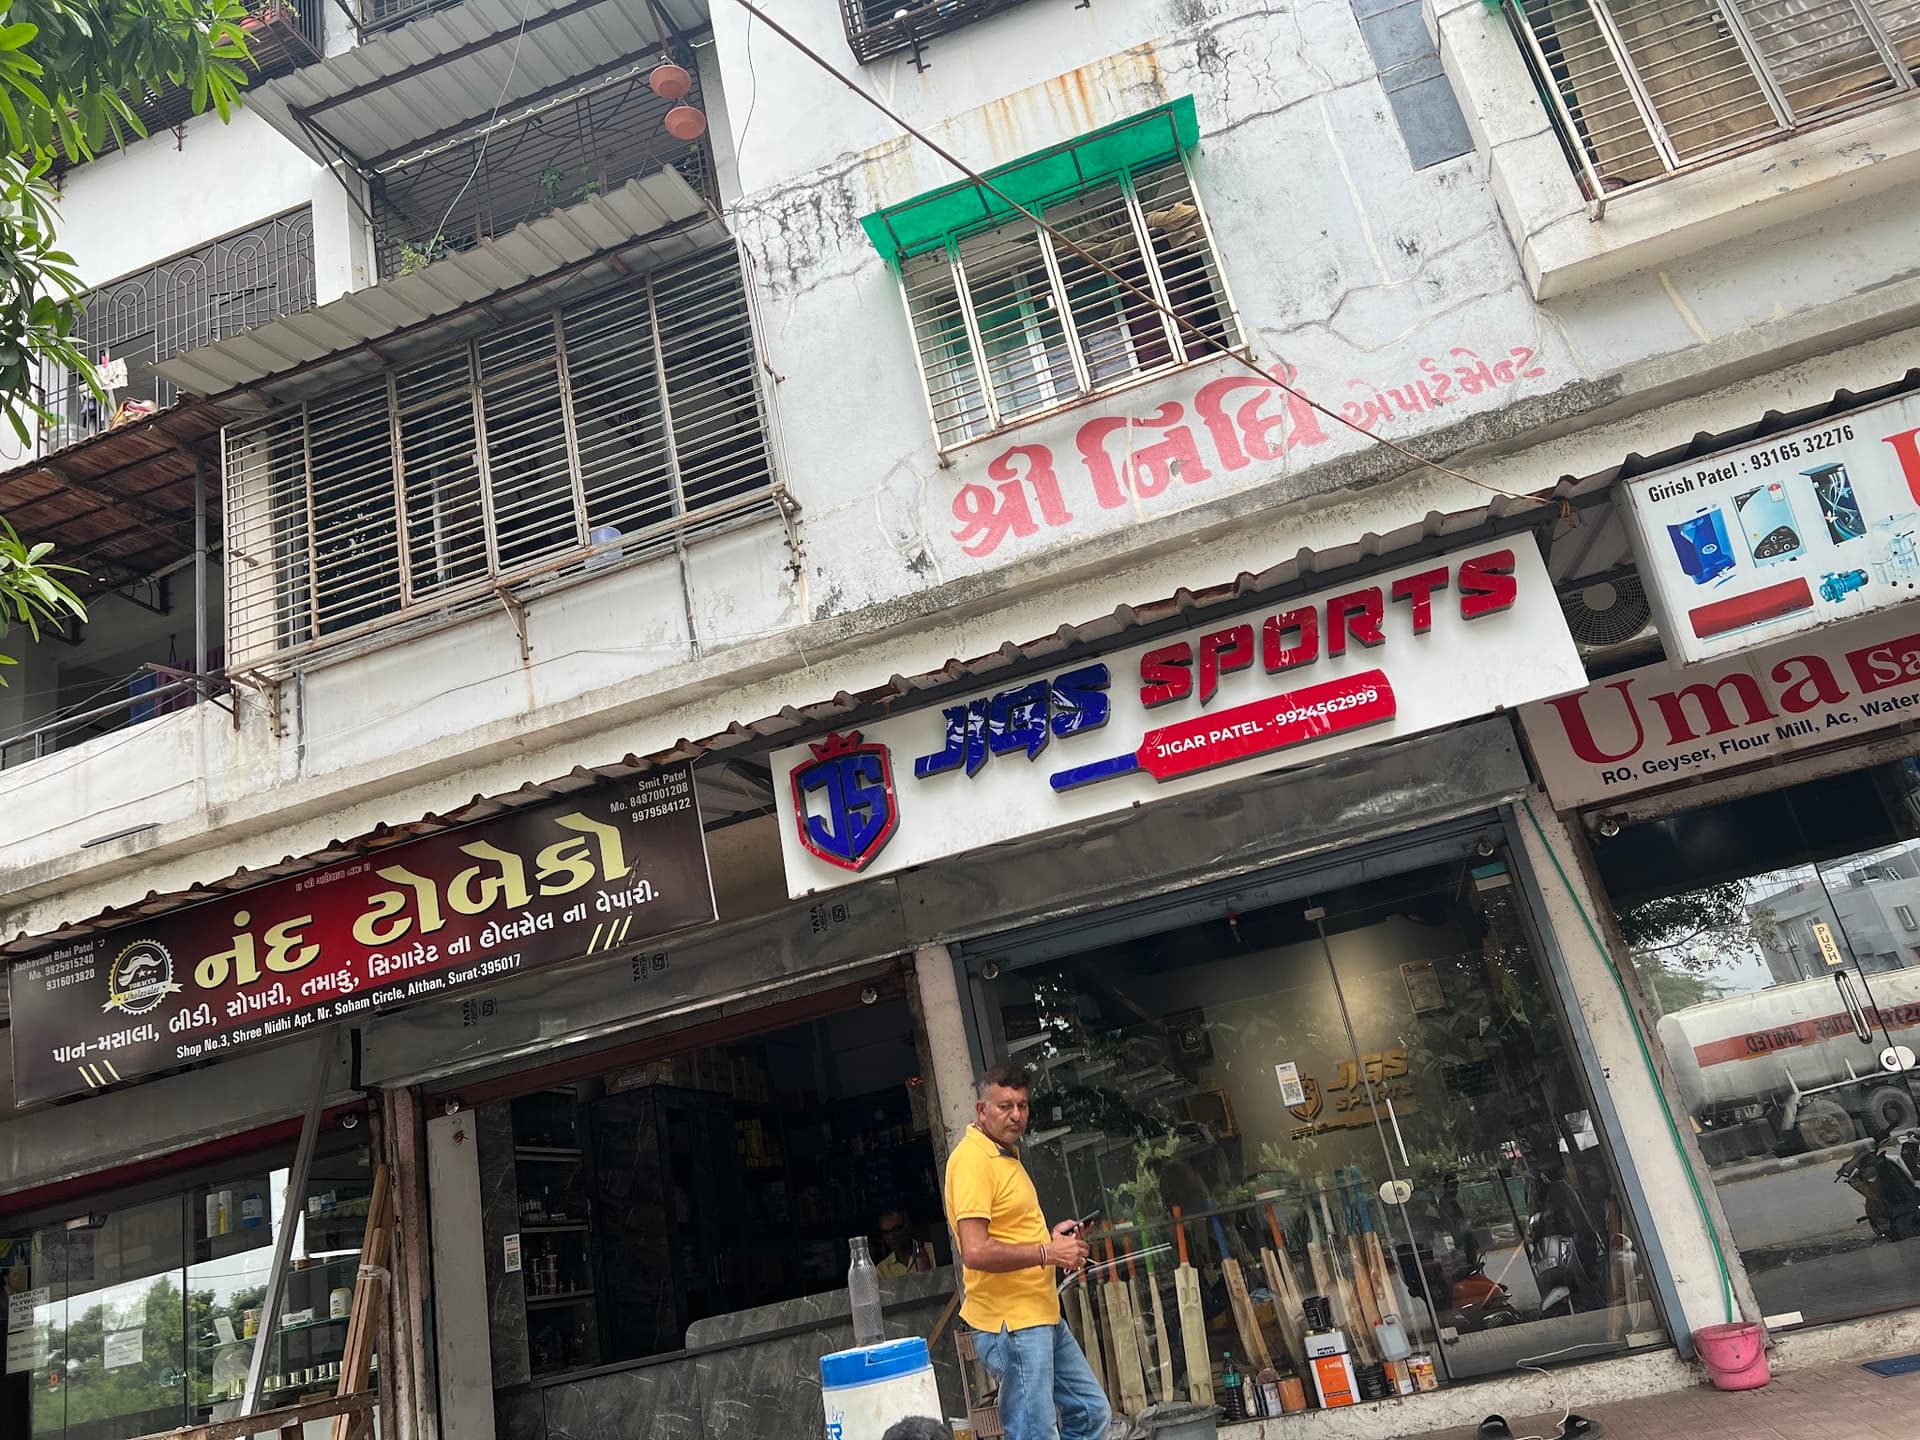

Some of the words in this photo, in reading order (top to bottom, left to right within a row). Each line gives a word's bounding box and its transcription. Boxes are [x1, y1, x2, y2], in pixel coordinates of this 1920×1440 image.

[1648, 477, 1694, 503] Girish
[1698, 463, 1738, 490] Patel
[1751, 444, 1801, 472] 93165
[1803, 424, 1854, 455] 32276
[951, 444, 1073, 558] શ્રી
[1140, 548, 1518, 706] SPORTS
[1156, 734, 1206, 758] JIGAR
[1209, 720, 1263, 743] PATEL
[1275, 689, 1378, 727] 9924562999
[1545, 654, 1851, 765] Uma
[1602, 766, 1638, 785] RO,
[1642, 746, 1716, 775] Geyser,
[1719, 732, 1771, 755] Flour
[1775, 719, 1820, 740] Mill,
[1826, 710, 1858, 729] Ac,
[1860, 694, 1920, 717] Water
[609, 802, 628, 813] Mo.
[629, 782, 689, 808] 8487001208
[632, 797, 691, 823] 9979584122
[638, 778, 661, 791] Smit
[662, 769, 687, 785] Patel
[193, 908, 321, 990] નંદ
[351, 812, 634, 946] ટોબેકો
[13, 955, 52, 973] Jashavant
[54, 948, 73, 963] Bhai
[73, 941, 94, 958] Patel
[45, 954, 95, 976] 9825815240
[46, 968, 95, 991] 9316013820
[1817, 926, 1838, 961] PUSH
[53, 1023, 160, 1064] પાન-મસાલા,
[168, 1002, 218, 1035] બીડી,
[226, 982, 292, 1019] સોપારી,
[367, 942, 439, 978] સિગારેટ
[447, 935, 471, 956] ના
[479, 911, 554, 949] હોલસેલ
[563, 903, 587, 924] ના
[176, 1042, 202, 1060] Shop
[203, 1033, 231, 1053] No.3,
[233, 1023, 262, 1043] Shree
[264, 1016, 292, 1035] Nidhi
[294, 1010, 315, 1028] Apt.
[317, 1006, 333, 1021] Nr.
[335, 996, 371, 1015] Soham
[372, 986, 406, 1006] Circle,
[407, 977, 446, 998] Althan,
[448, 953, 522, 986] Surat-395017
